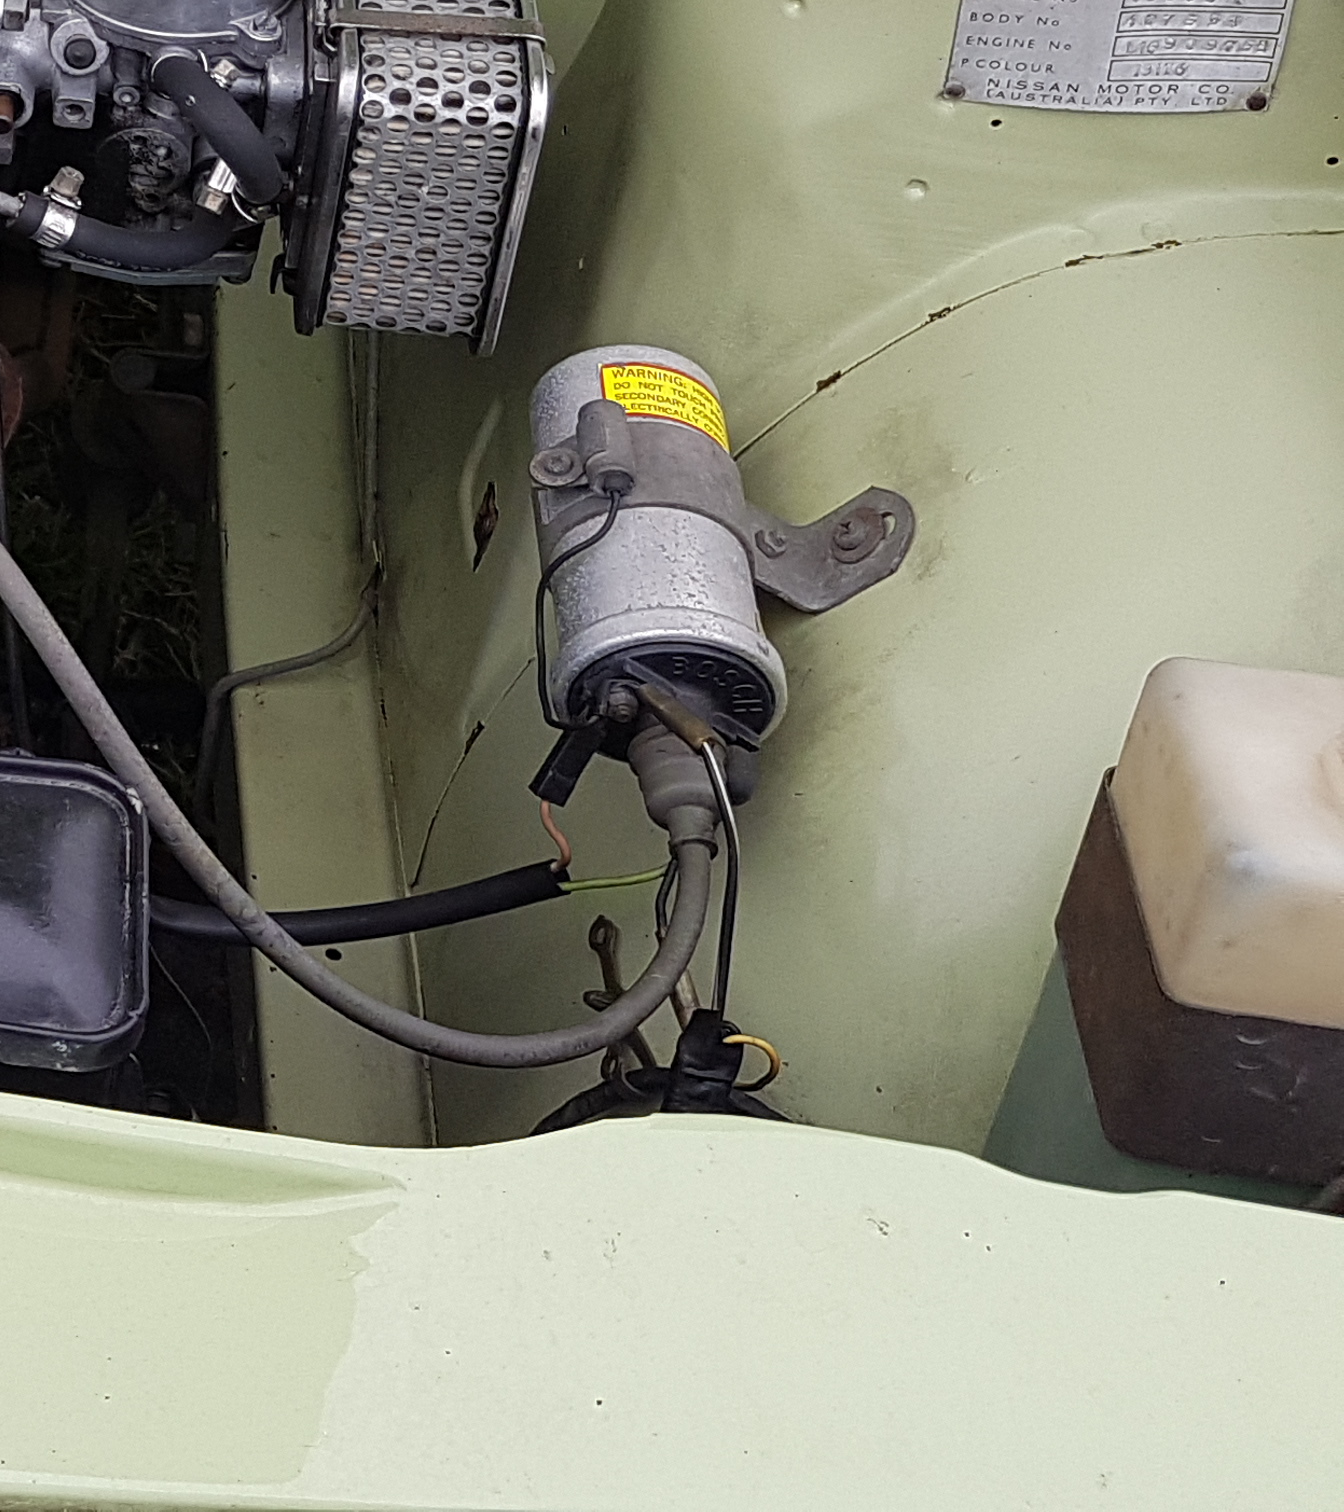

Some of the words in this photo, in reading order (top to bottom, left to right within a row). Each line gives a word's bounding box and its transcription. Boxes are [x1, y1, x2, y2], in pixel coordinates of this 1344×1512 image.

[969, 12, 1024, 25] BODY
[1036, 16, 1060, 26] No
[965, 35, 1037, 49] ENGINE
[1048, 40, 1072, 51] No
[975, 59, 1055, 73] COLOUR
[987, 78, 1080, 93] NISSAN
[1097, 84, 1180, 94] MOTOR
[986, 90, 1123, 106] (AUSTRALIA)
[611, 368, 688, 387] WARNING:
[613, 382, 631, 390] DO
[638, 381, 664, 392] NOT
[671, 387, 706, 409] TOUCH
[614, 392, 687, 409] SECONDARY
[671, 654, 766, 714] BOSCH
